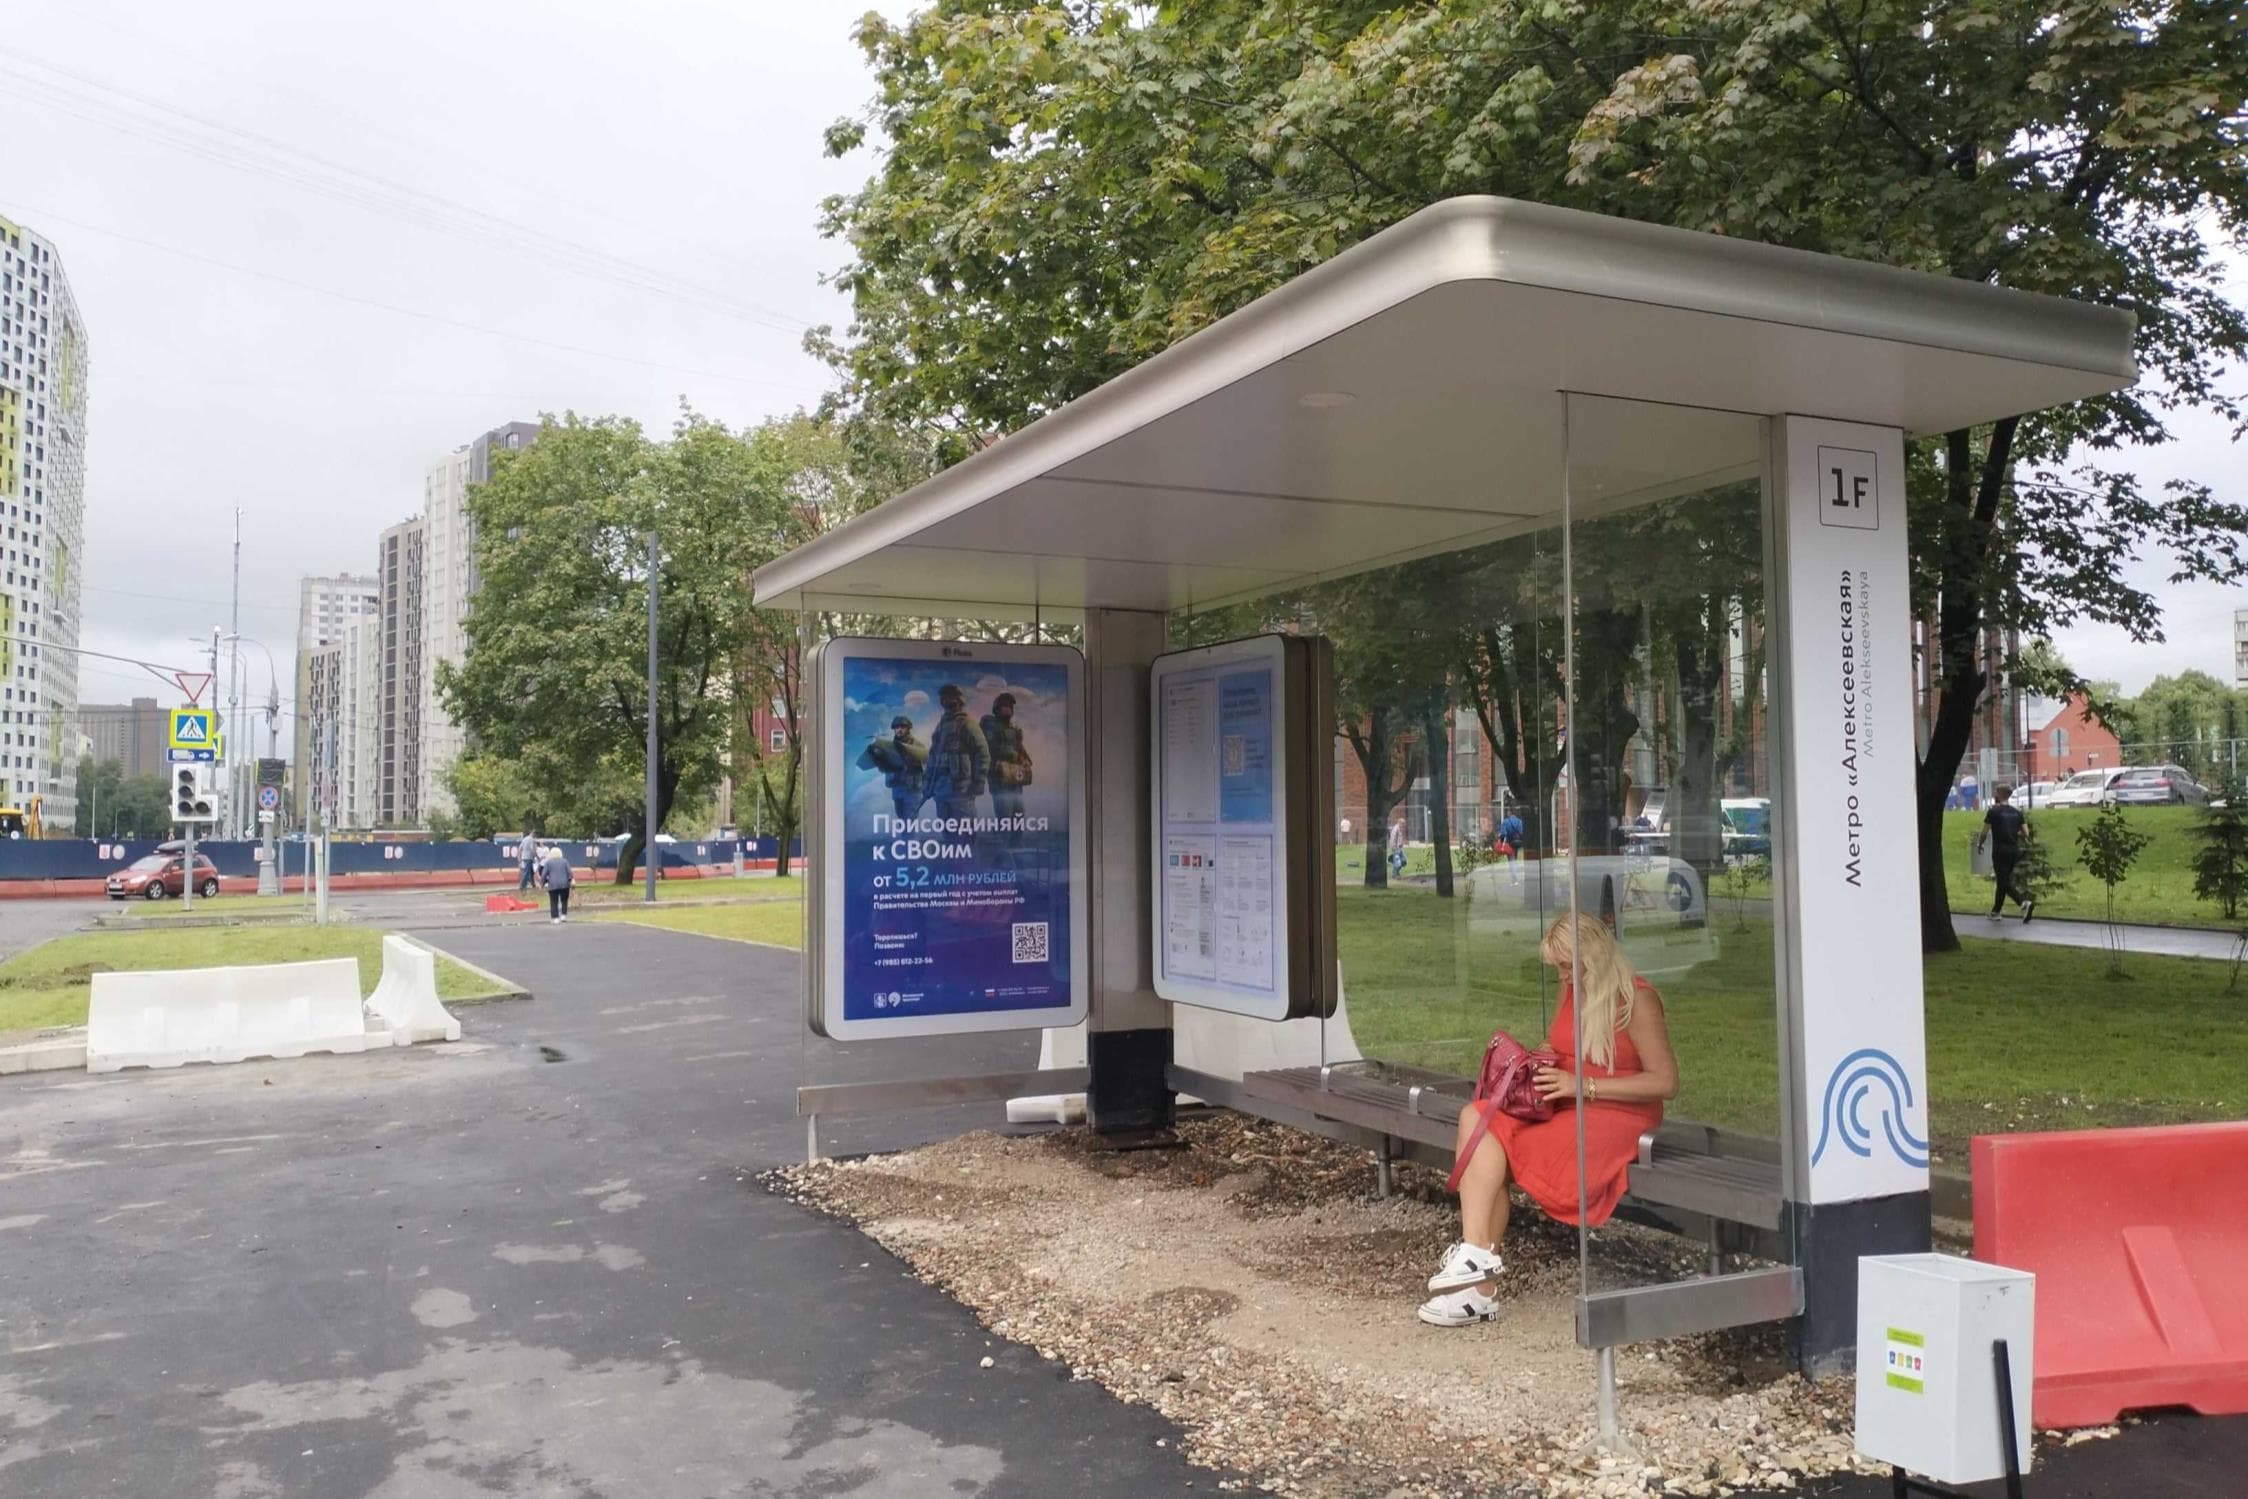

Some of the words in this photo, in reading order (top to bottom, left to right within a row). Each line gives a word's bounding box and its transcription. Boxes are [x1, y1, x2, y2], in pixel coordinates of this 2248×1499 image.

[1831, 467, 1869, 508] 1F
[1858, 570, 1872, 698] Alekseevskaya
[1840, 570, 1858, 786] «Алексеевская»
[1863, 702, 1875, 758] Metro
[873, 813, 1049, 837] Присоединяйся
[1845, 795, 1863, 887] Метро
[873, 846, 886, 860] к
[891, 839, 972, 860] СВОим
[873, 875, 892, 887] от
[896, 866, 929, 889] 5,2
[934, 874, 965, 885] МЛН
[968, 870, 1017, 884] РУБЛЕЙ
[874, 902, 928, 910] Правительства
[920, 890, 947, 898] первый
